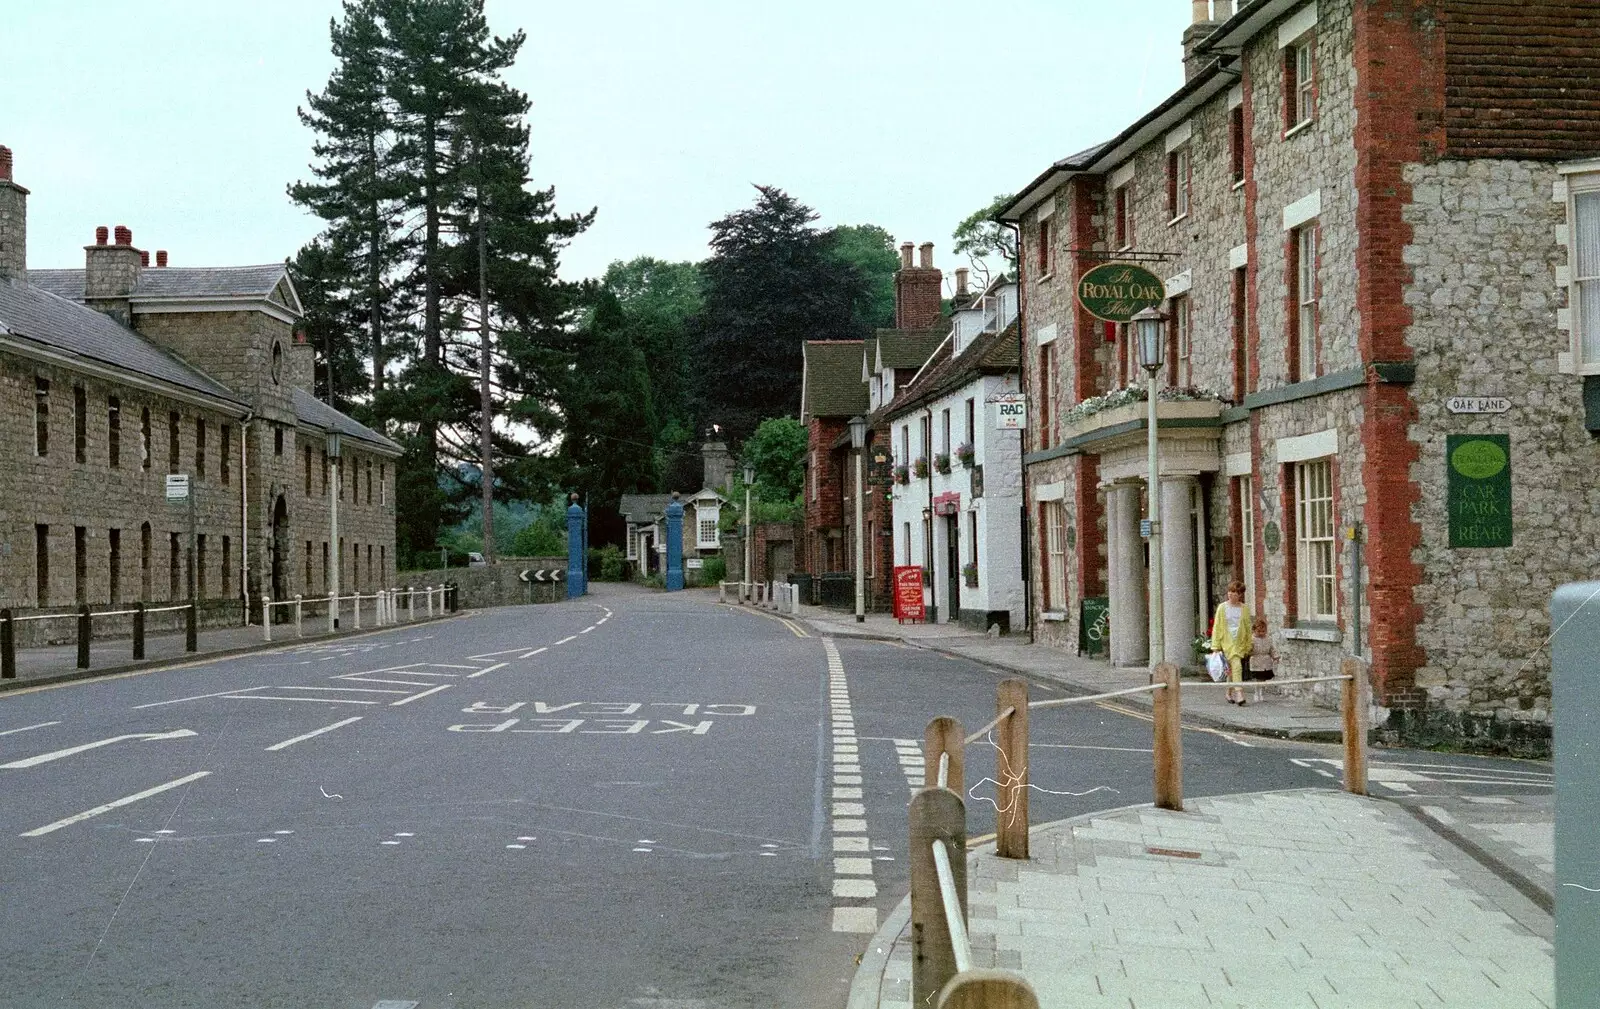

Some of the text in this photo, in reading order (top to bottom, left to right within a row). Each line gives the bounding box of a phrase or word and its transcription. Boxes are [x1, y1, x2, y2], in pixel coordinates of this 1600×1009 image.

[1109, 268, 1134, 283] The
[1083, 282, 1161, 300] ROYAL OAK
[1102, 300, 1135, 315] Hotel
[1000, 404, 1023, 415] RAC
[1453, 401, 1505, 410] OAK LANE
[1463, 485, 1495, 499] CAR
[1459, 501, 1500, 514] PARK
[1459, 527, 1502, 541] REAR
[461, 701, 757, 716] CLEAR
[446, 718, 714, 735] KEEP
